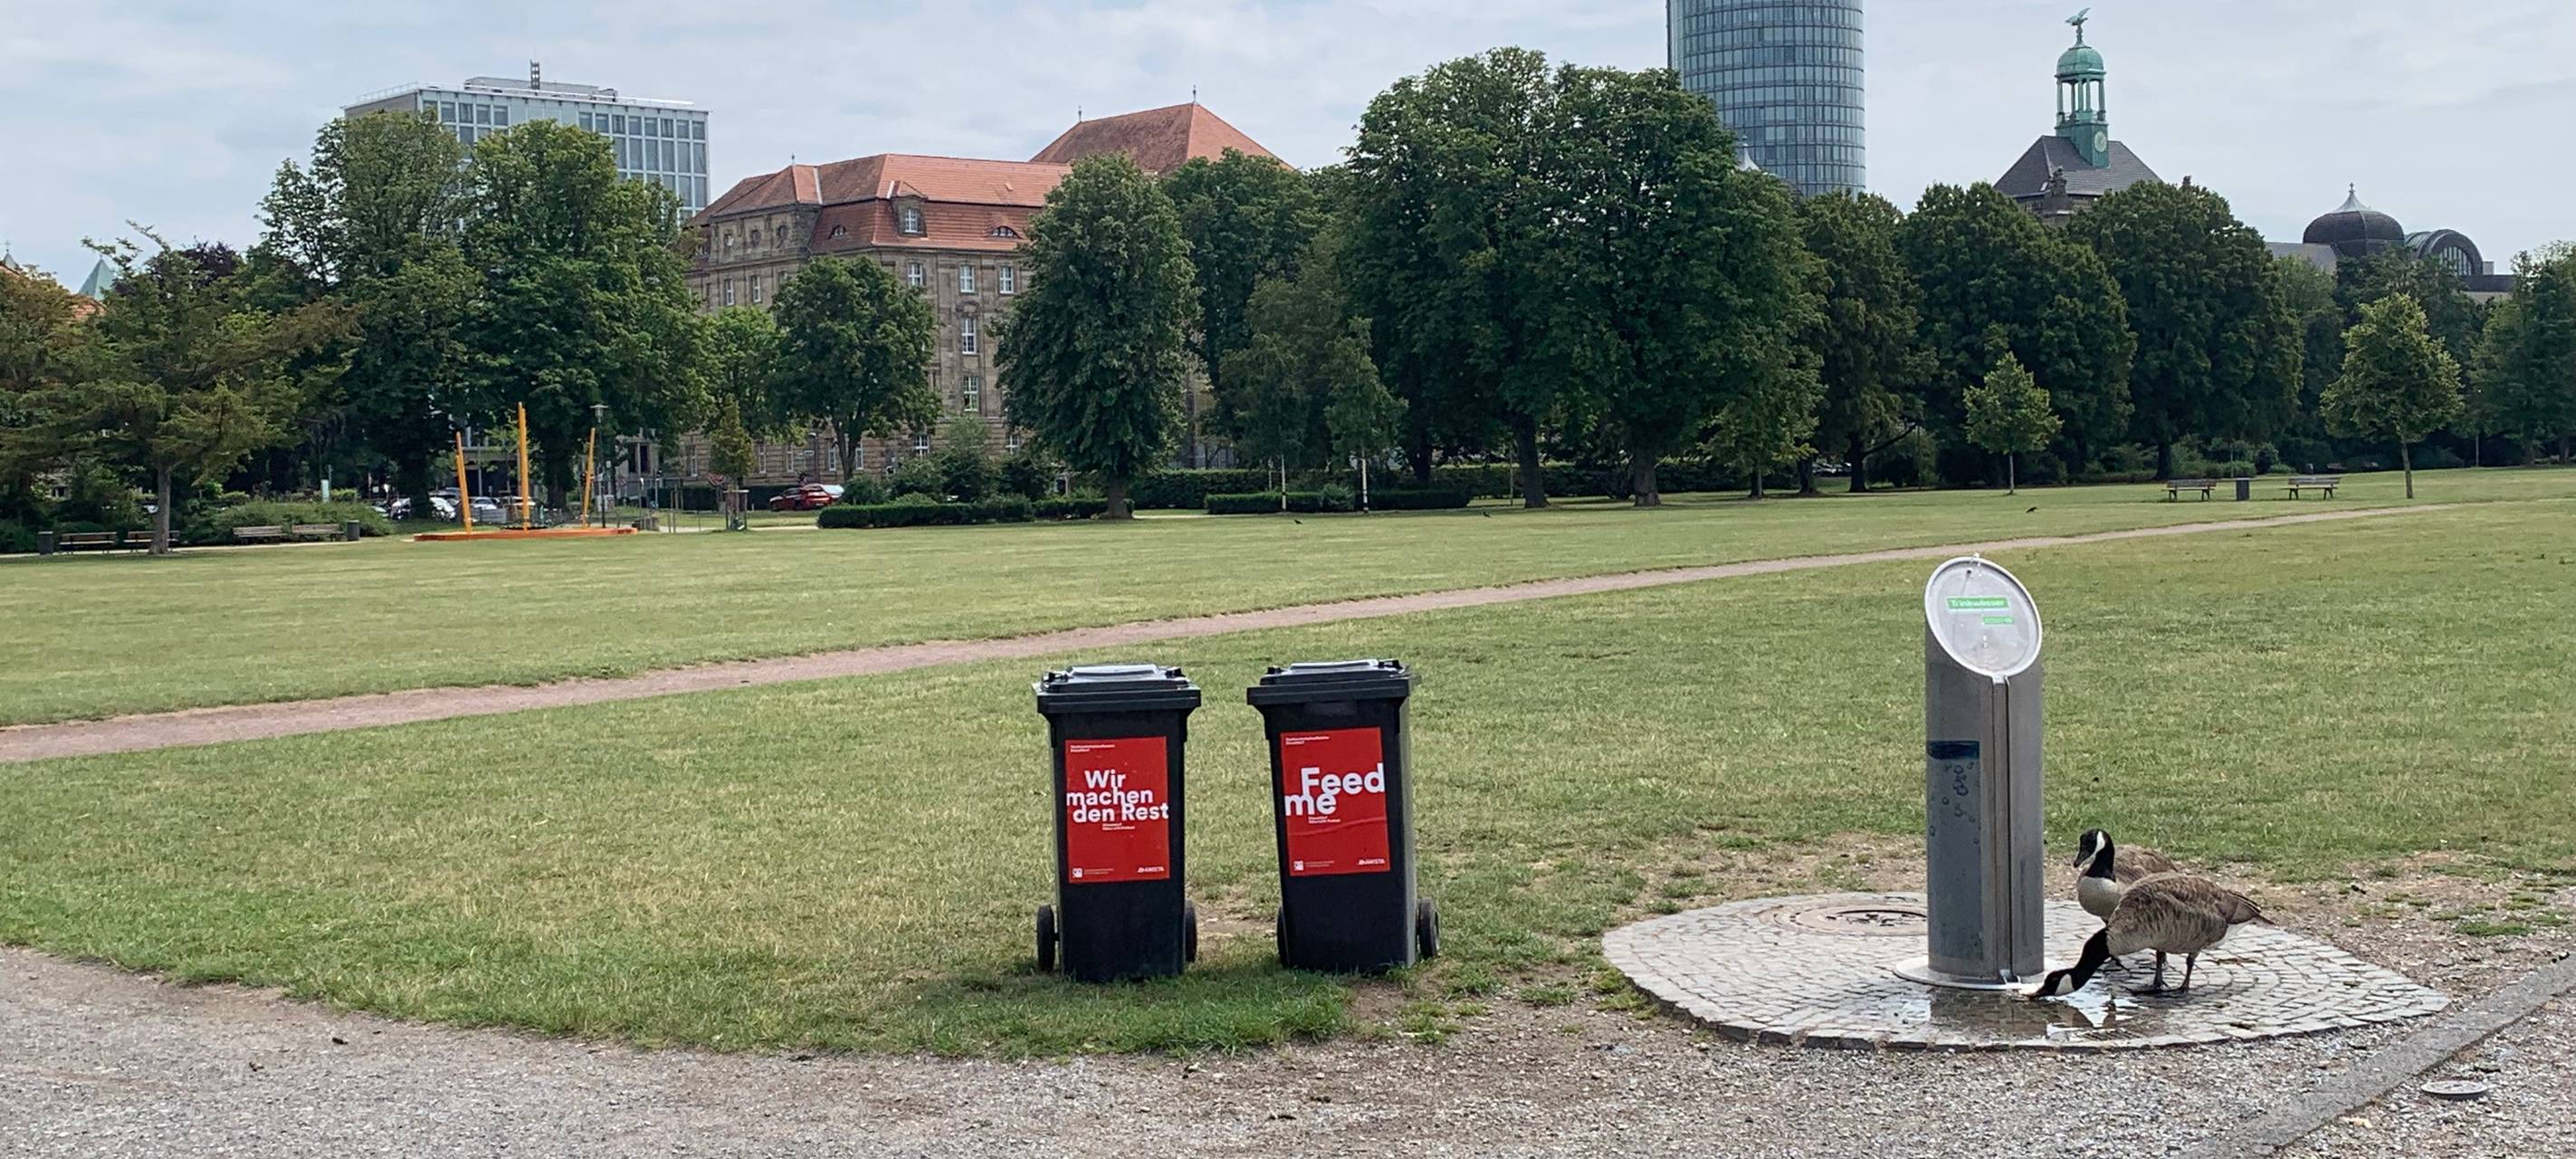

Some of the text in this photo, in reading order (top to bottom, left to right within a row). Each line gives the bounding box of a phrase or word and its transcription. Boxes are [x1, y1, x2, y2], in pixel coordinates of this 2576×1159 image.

[1084, 769, 1126, 789] Wir
[1301, 762, 1386, 795] Feed
[1066, 786, 1153, 806] machen
[1284, 793, 1337, 816] me
[1073, 802, 1169, 823] den Rest
